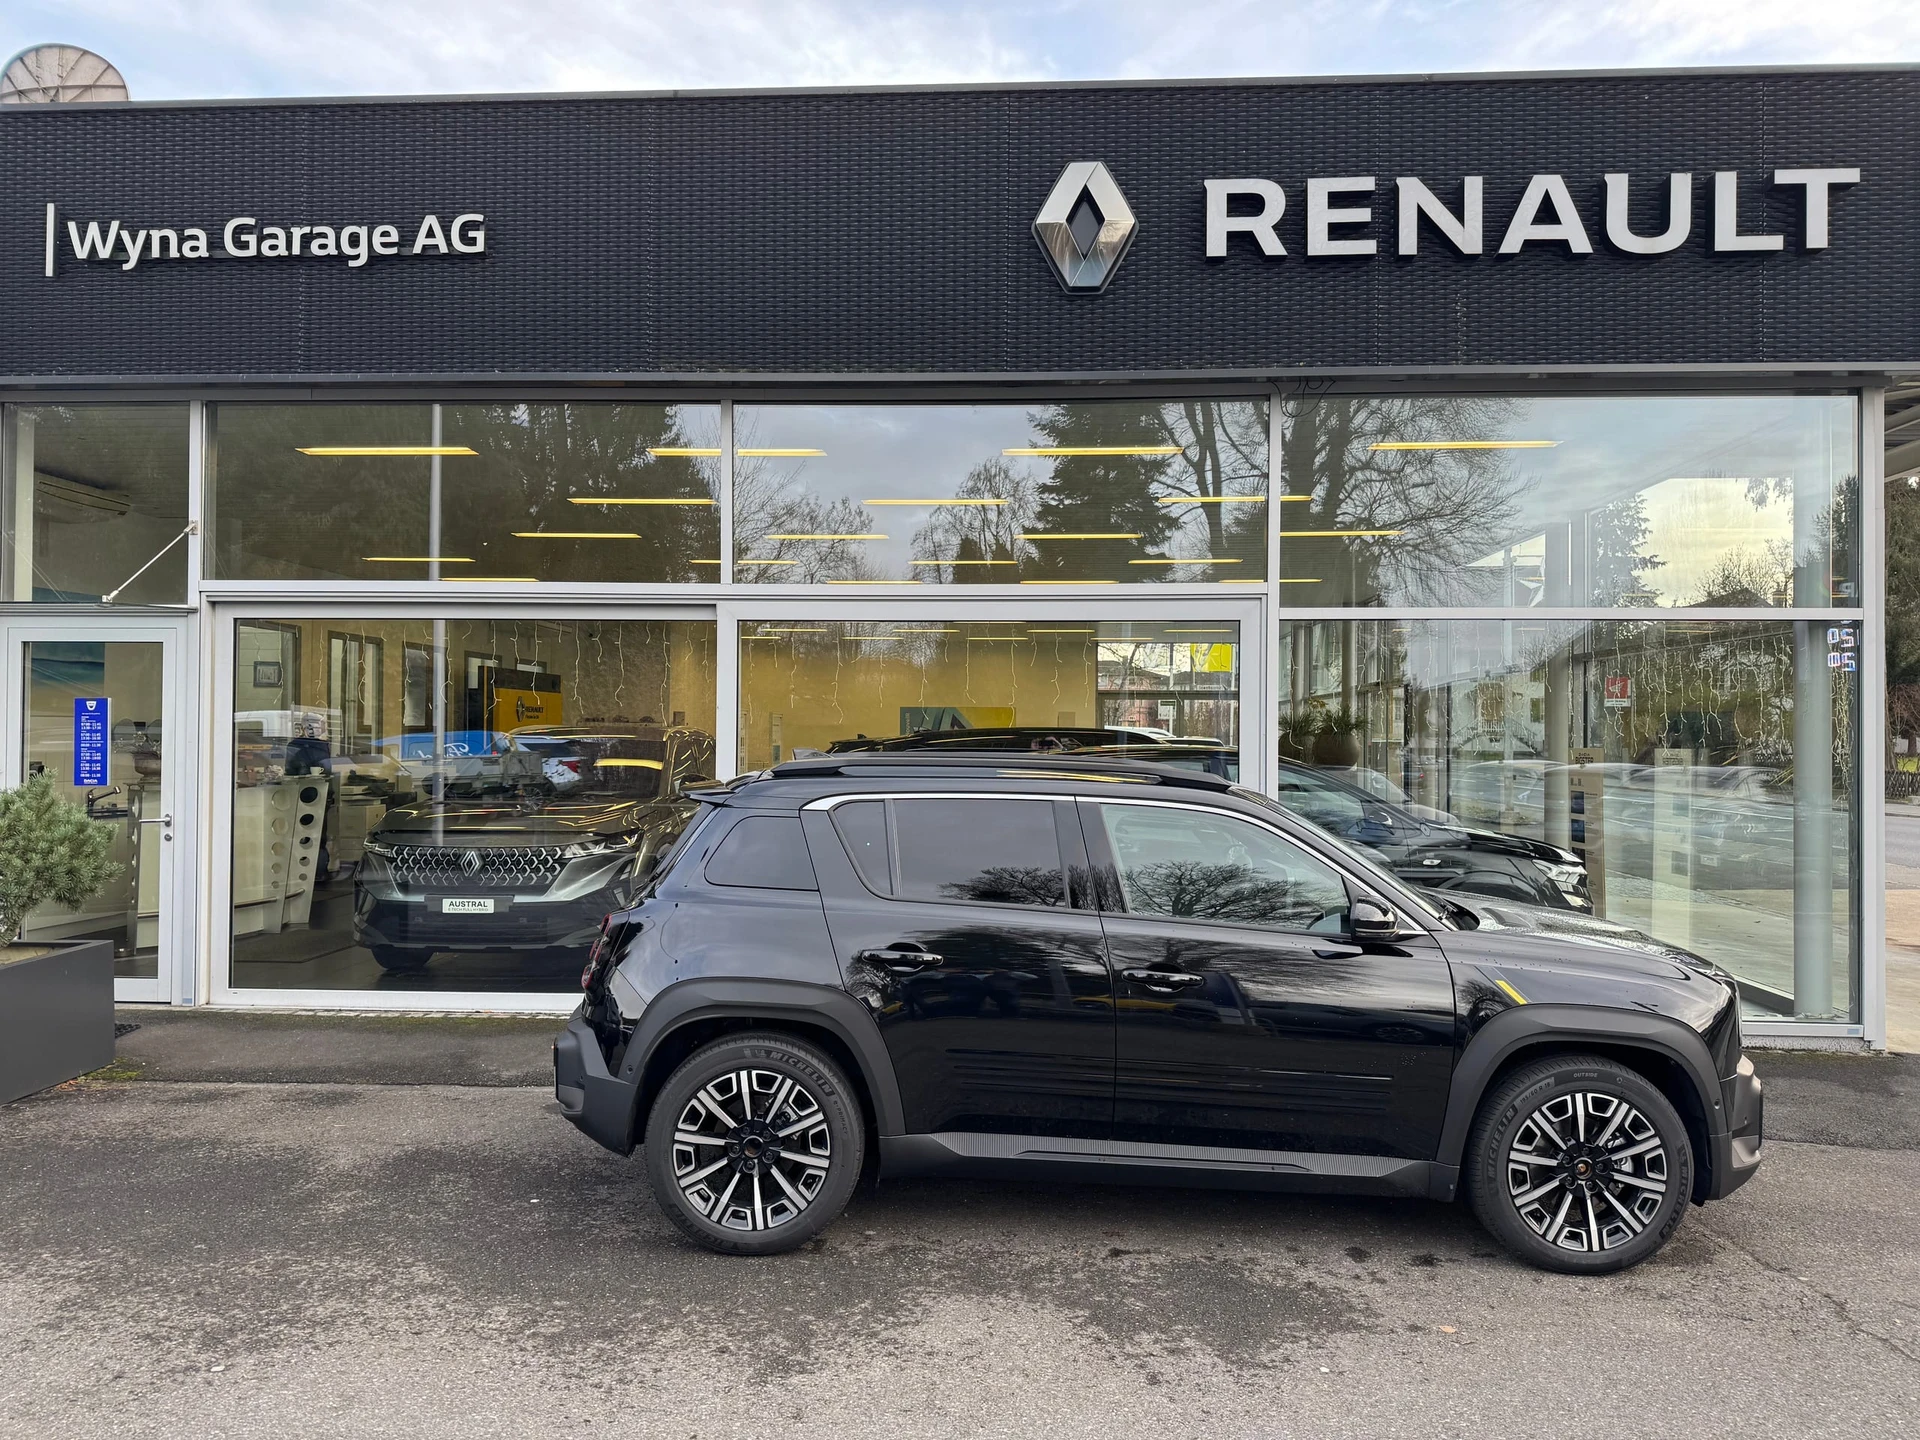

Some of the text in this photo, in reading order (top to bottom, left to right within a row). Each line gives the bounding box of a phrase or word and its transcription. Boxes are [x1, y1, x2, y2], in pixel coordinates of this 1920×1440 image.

[68, 213, 486, 270] Wyna Garage AG
[1203, 168, 1861, 257] RENAULT
[770, 1051, 833, 1093] MICHELIN
[1487, 1108, 1515, 1178] MICHELIN
